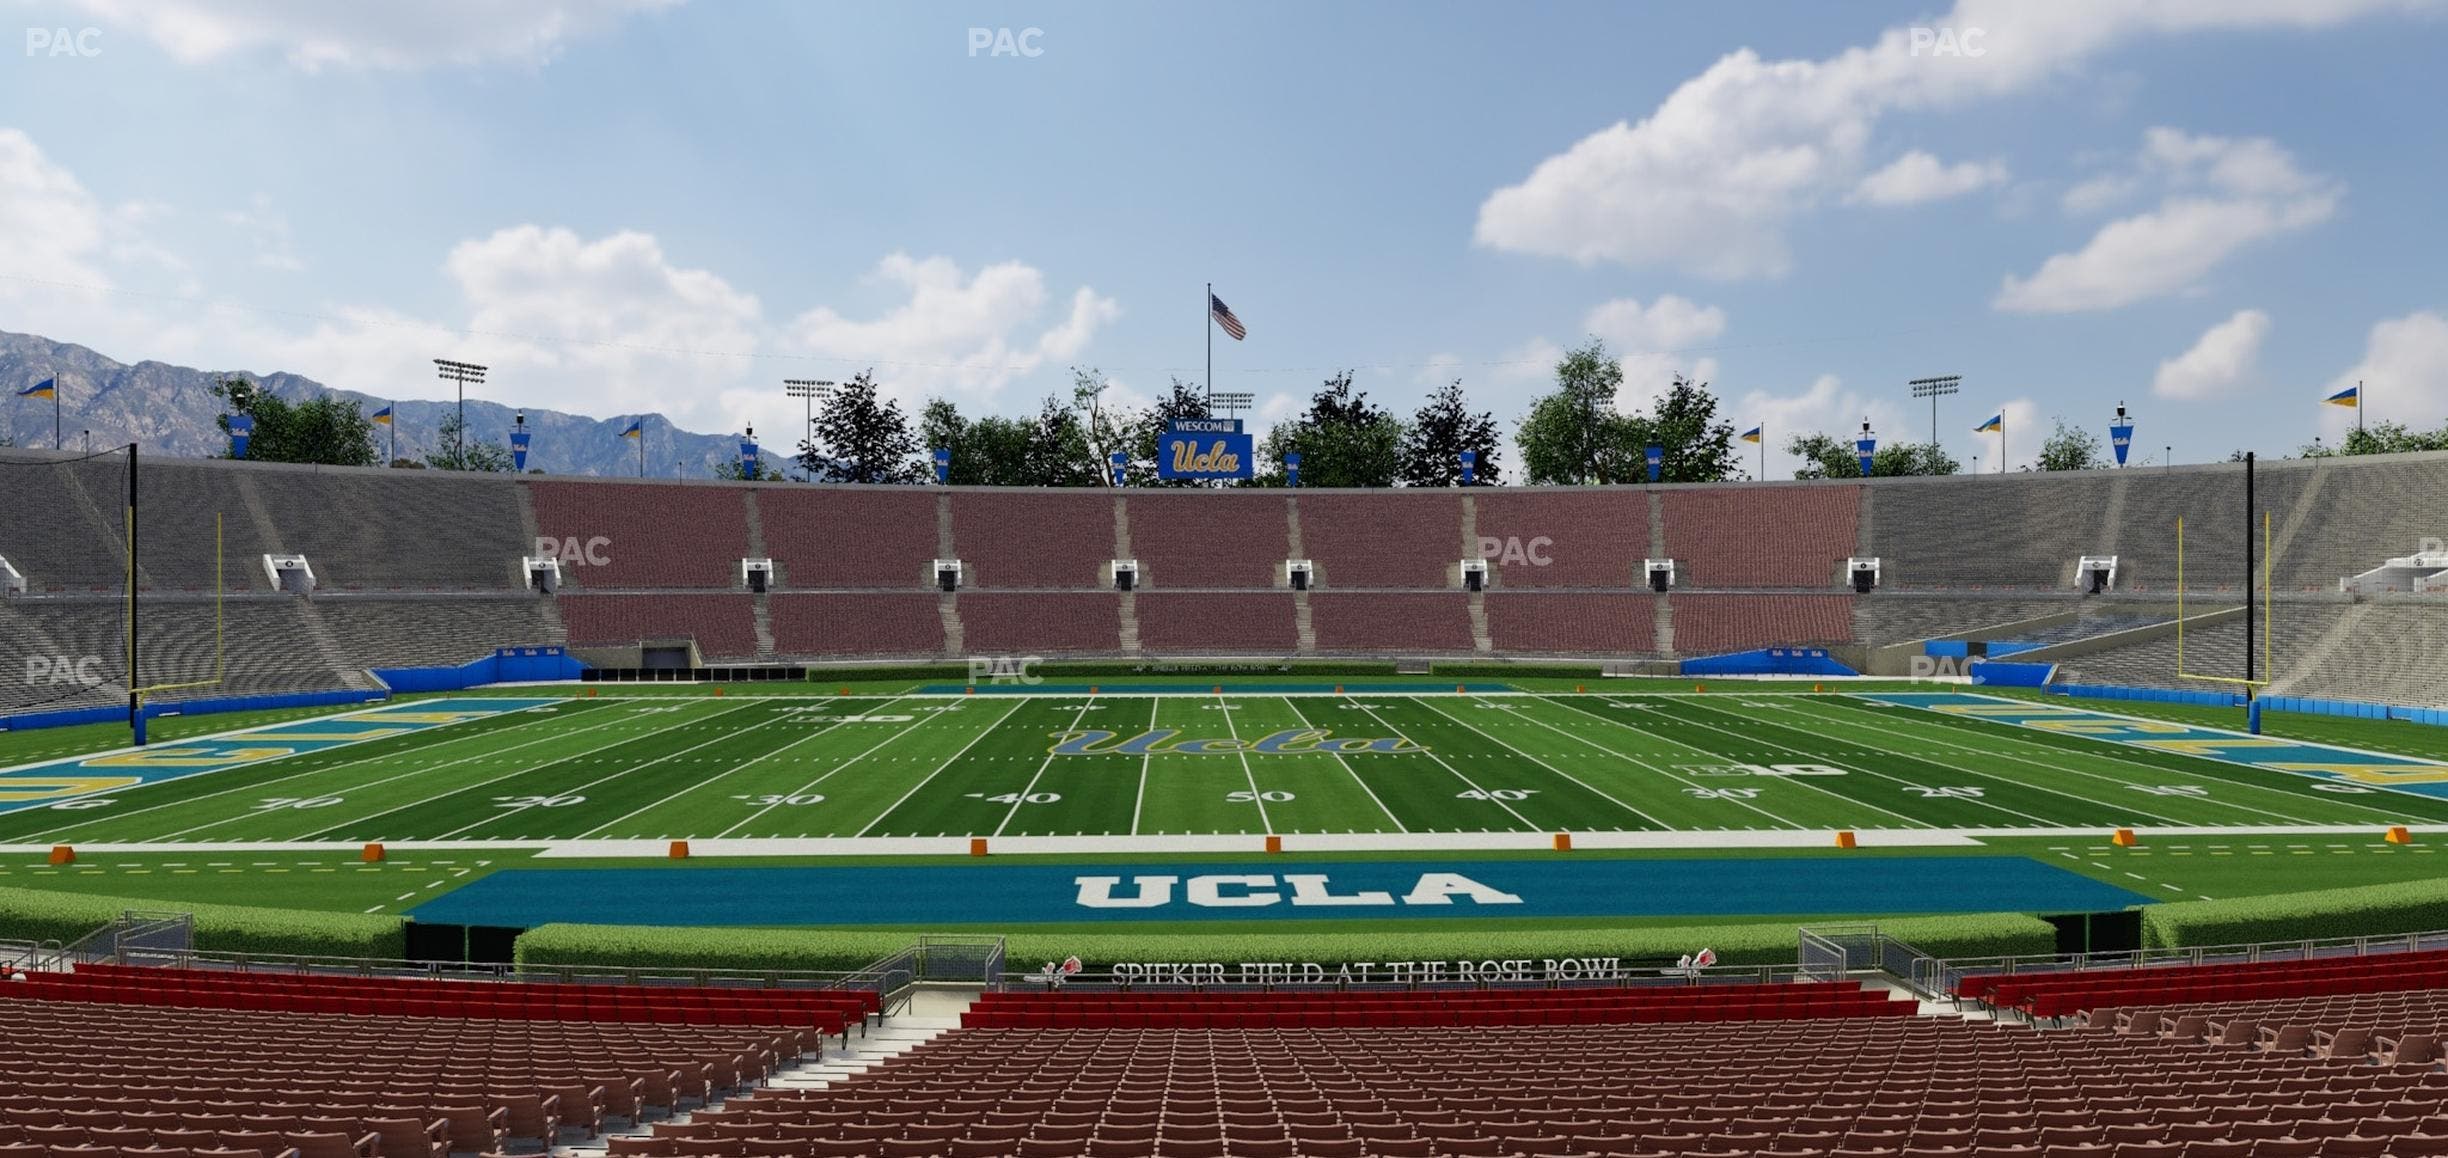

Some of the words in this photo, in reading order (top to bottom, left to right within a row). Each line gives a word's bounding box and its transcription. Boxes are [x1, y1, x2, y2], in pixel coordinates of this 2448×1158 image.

[1175, 421, 1222, 431] WESCOM
[1171, 440, 1240, 472] Ucla
[1047, 729, 1432, 755] Ucla
[745, 794, 825, 806] 30
[986, 793, 1061, 804] 40
[1225, 791, 1296, 802] 50
[1456, 789, 1528, 800] 40
[1075, 872, 1524, 908] UCLA
[1112, 963, 1227, 985] SPIEKER
[1240, 963, 1324, 984] FIELD
[1334, 962, 1375, 984] AT
[1385, 961, 1448, 983] THE
[1458, 959, 1534, 982] ROSE
[1543, 957, 1630, 981] BOWL
